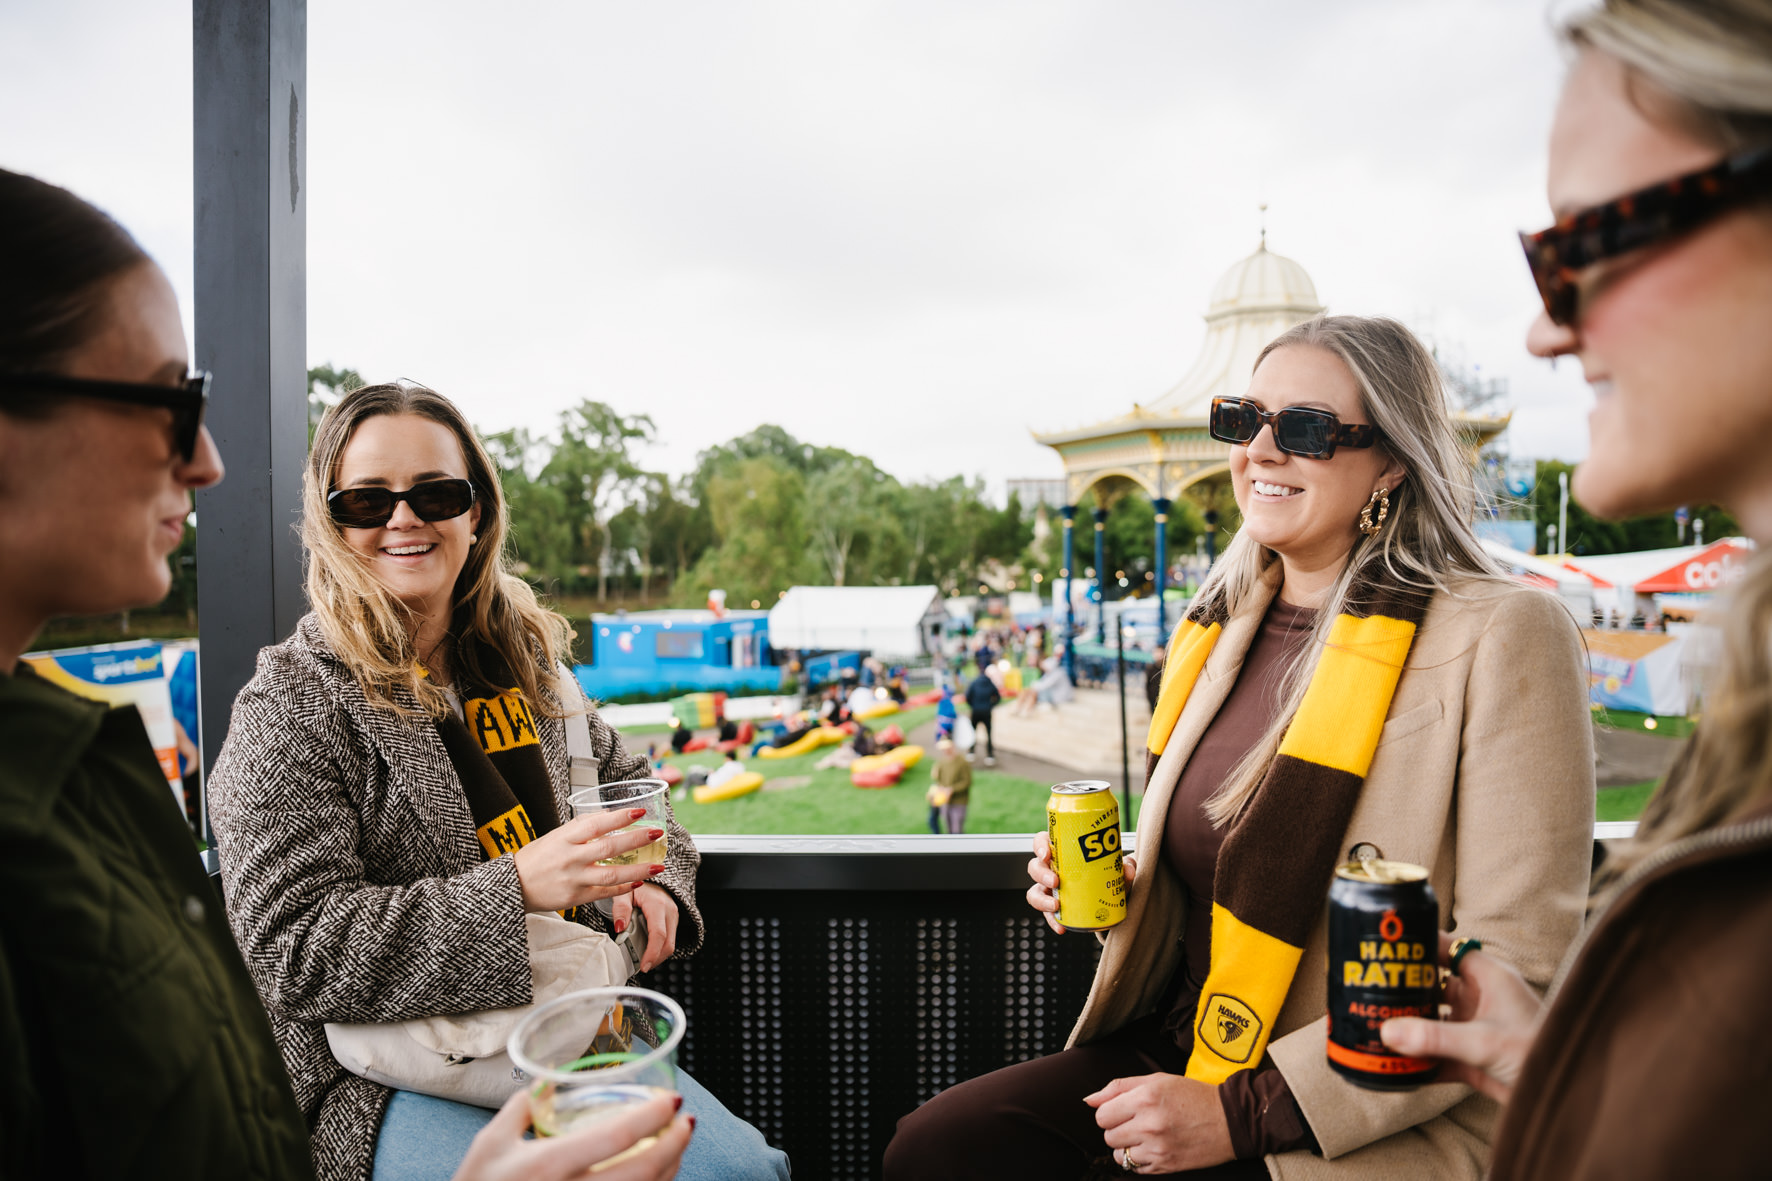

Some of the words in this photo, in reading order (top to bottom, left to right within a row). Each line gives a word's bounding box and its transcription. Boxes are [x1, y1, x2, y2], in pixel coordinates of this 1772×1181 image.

[1684, 553, 1747, 589] cole
[1084, 828, 1121, 858] SO
[1106, 877, 1123, 889] ORIG
[1360, 941, 1425, 961] HARD
[1343, 961, 1437, 988] RATED
[1217, 1004, 1250, 1029] HAWKS
